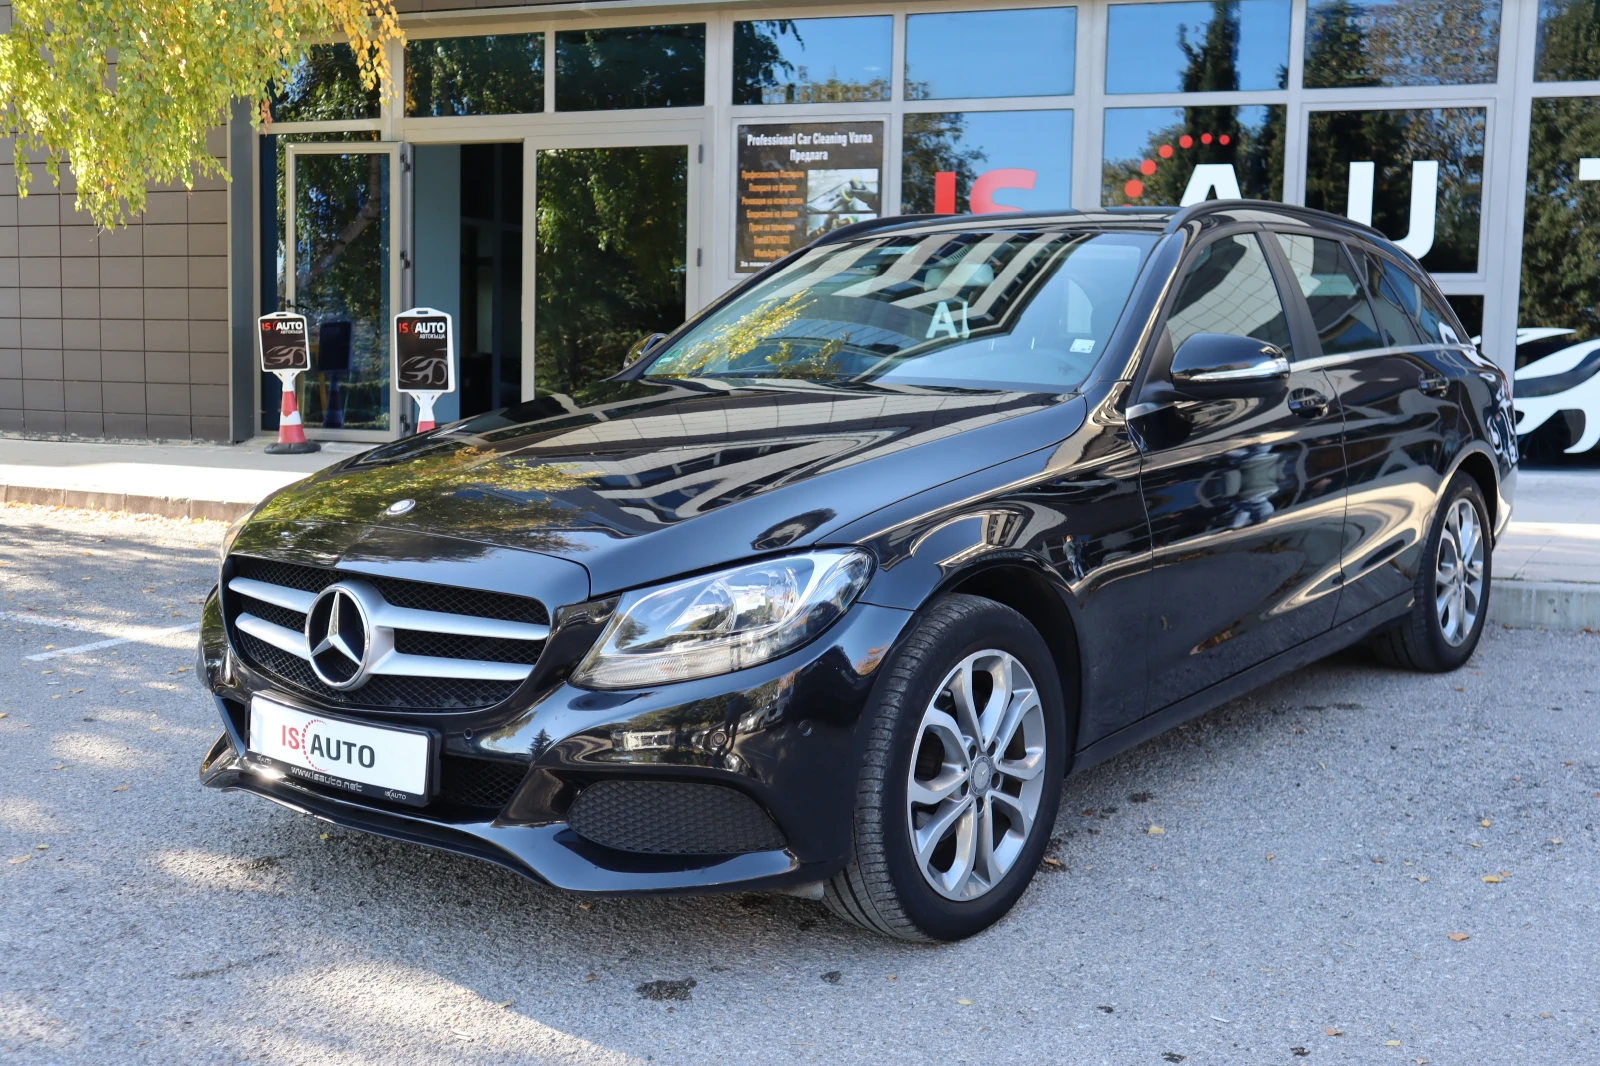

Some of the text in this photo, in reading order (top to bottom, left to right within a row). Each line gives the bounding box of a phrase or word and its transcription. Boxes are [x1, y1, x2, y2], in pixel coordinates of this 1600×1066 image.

[747, 132, 873, 147] Professional Car Cleaning Varna
[790, 149, 828, 163] Предлага
[262, 321, 303, 331] IS AUTO
[398, 322, 446, 334] IS AUTO
[282, 725, 376, 769] IS AUTO
[290, 766, 363, 792] www.isauto.net
